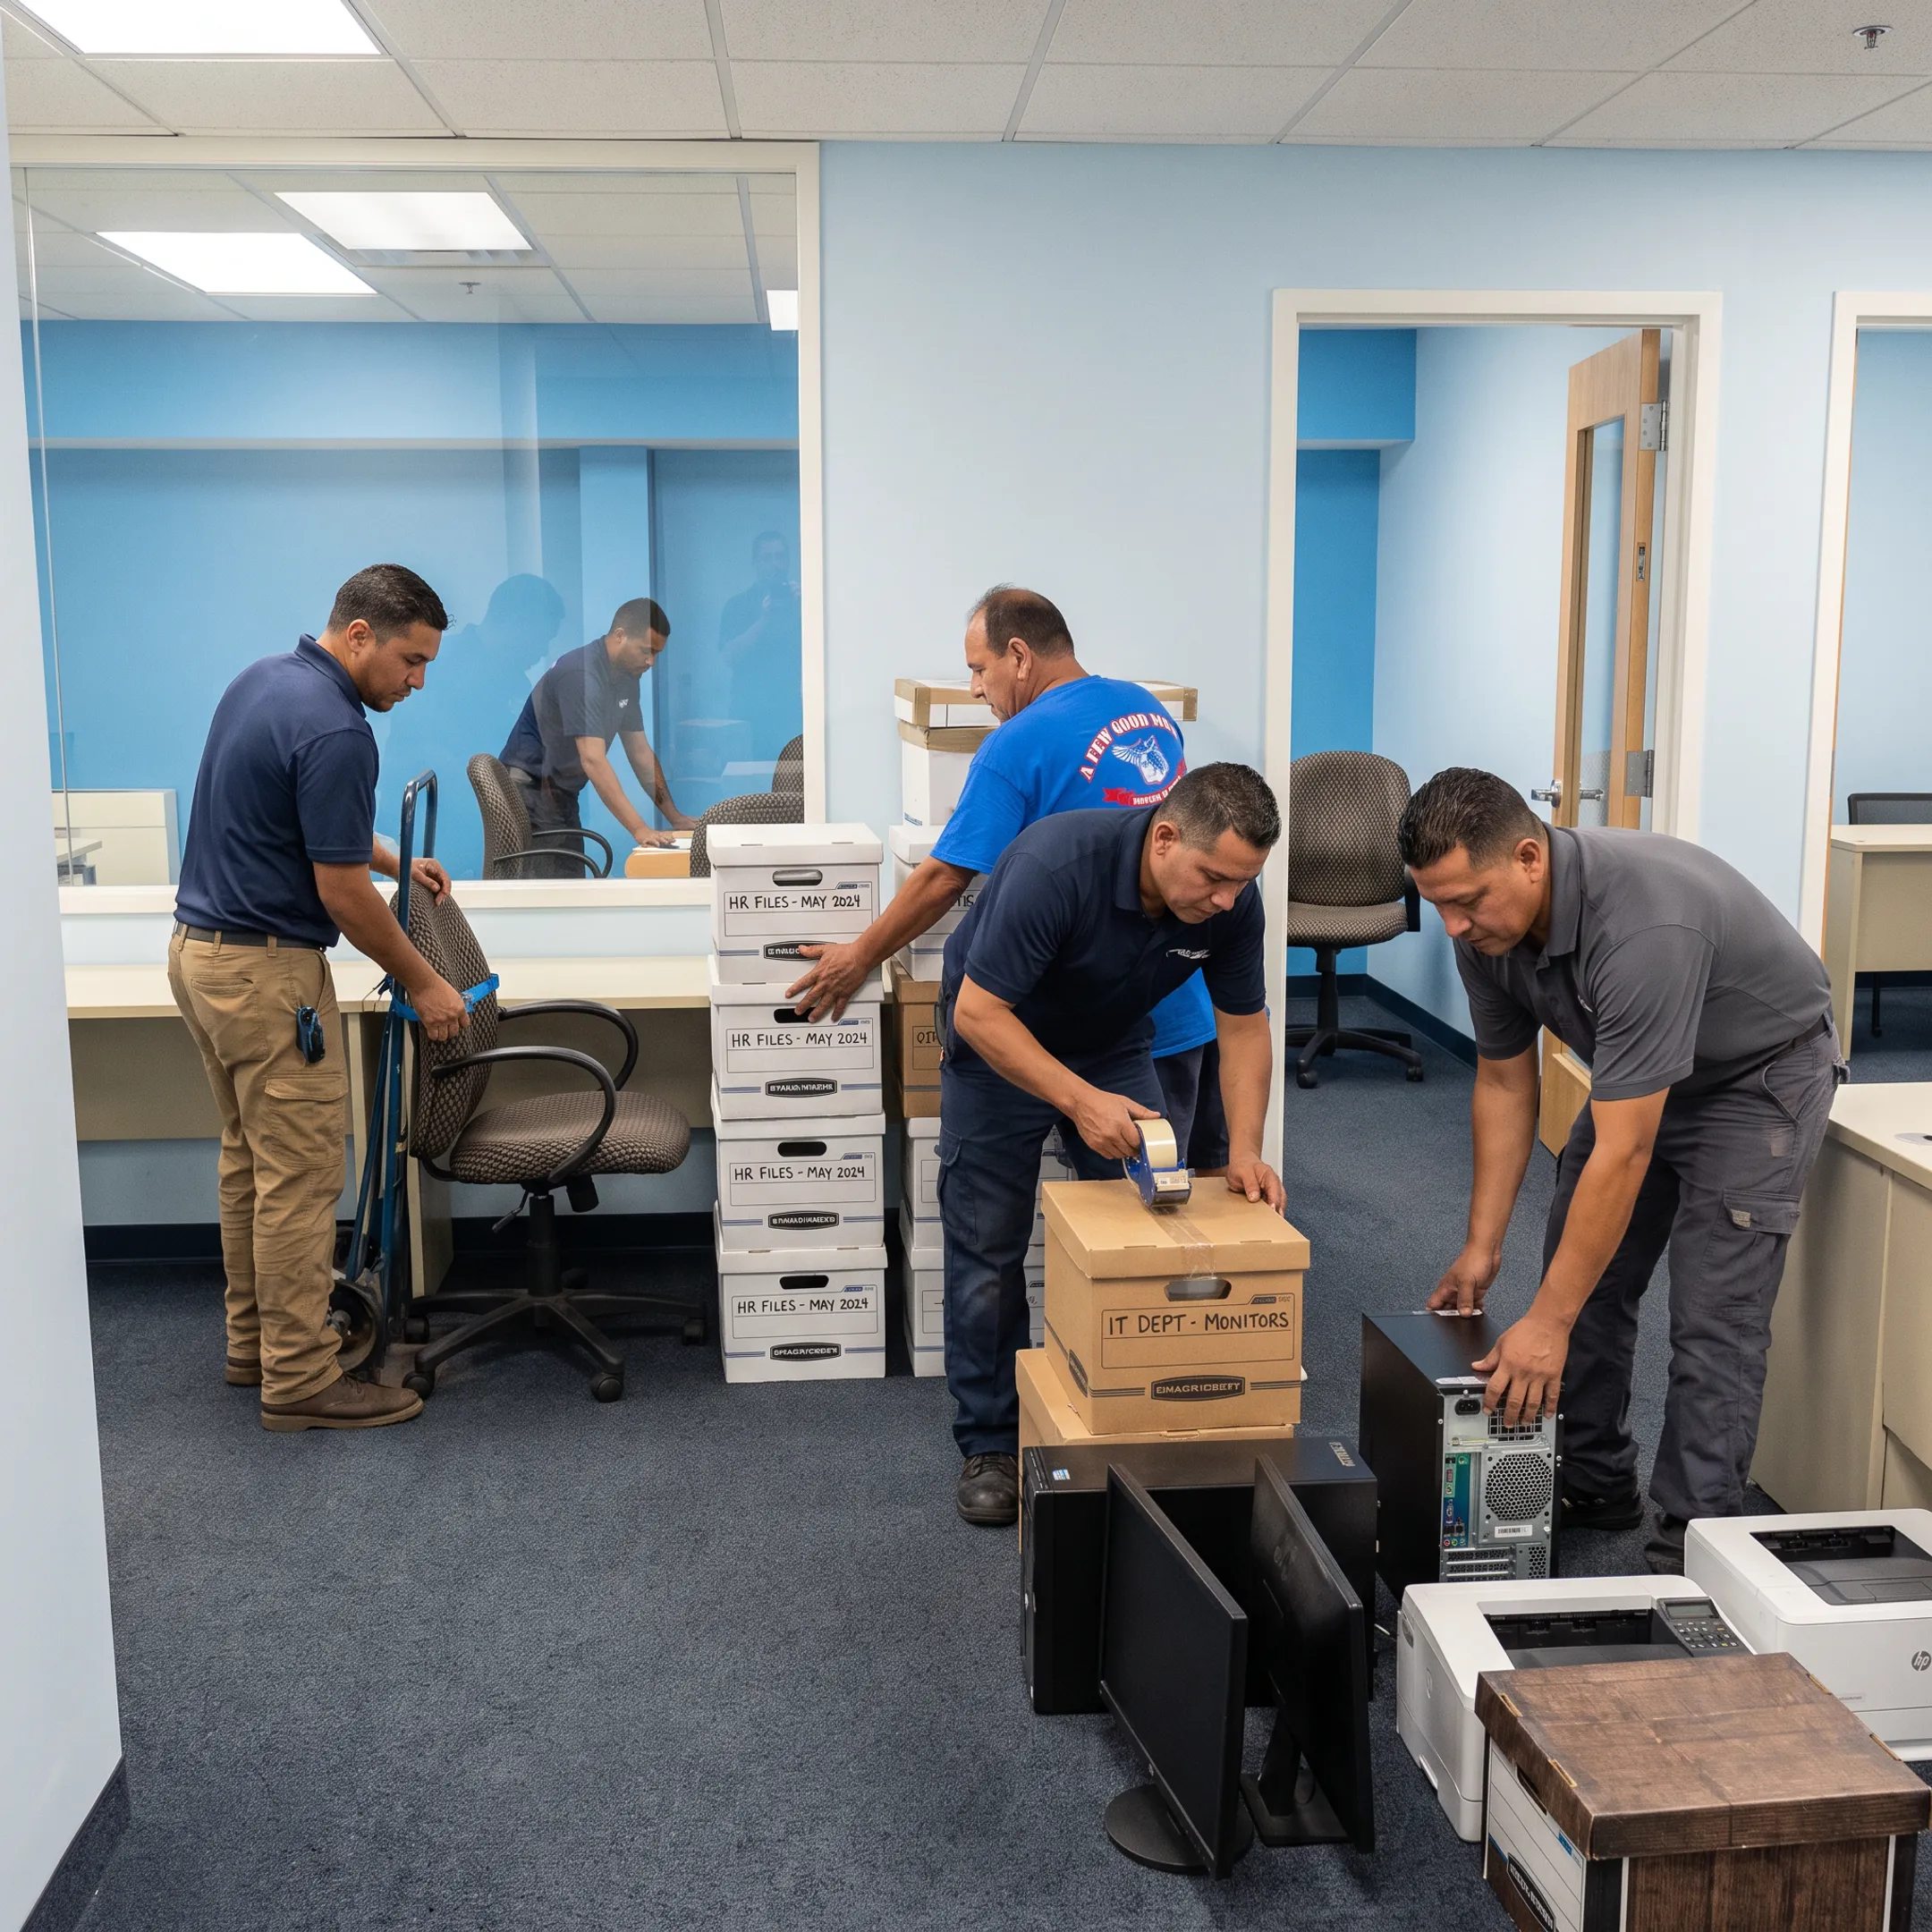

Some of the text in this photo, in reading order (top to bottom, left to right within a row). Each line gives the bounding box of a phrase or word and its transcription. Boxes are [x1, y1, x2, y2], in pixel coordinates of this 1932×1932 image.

[1110, 714, 1149, 734] GOOD
[1085, 726, 1113, 765] FEW
[1080, 766, 1095, 782] A
[729, 895, 750, 910] HR
[754, 895, 789, 909] FILES
[801, 895, 827, 909] MAY
[832, 894, 860, 908] 2024
[732, 1033, 751, 1047] HR
[757, 1033, 793, 1046] FILES
[805, 1032, 833, 1046] MAY
[837, 1031, 868, 1045] 2024
[734, 1166, 754, 1181] HR
[759, 1166, 794, 1180] FILES
[807, 1166, 833, 1180] MAY
[837, 1165, 865, 1179] 2024
[737, 1301, 757, 1314] HR
[761, 1300, 797, 1313] FILES
[809, 1299, 835, 1312] MAY
[840, 1297, 869, 1310] 2024
[1109, 1316, 1129, 1335] IT
[1138, 1314, 1187, 1334] DEPT
[1204, 1311, 1289, 1332] MONITORS
